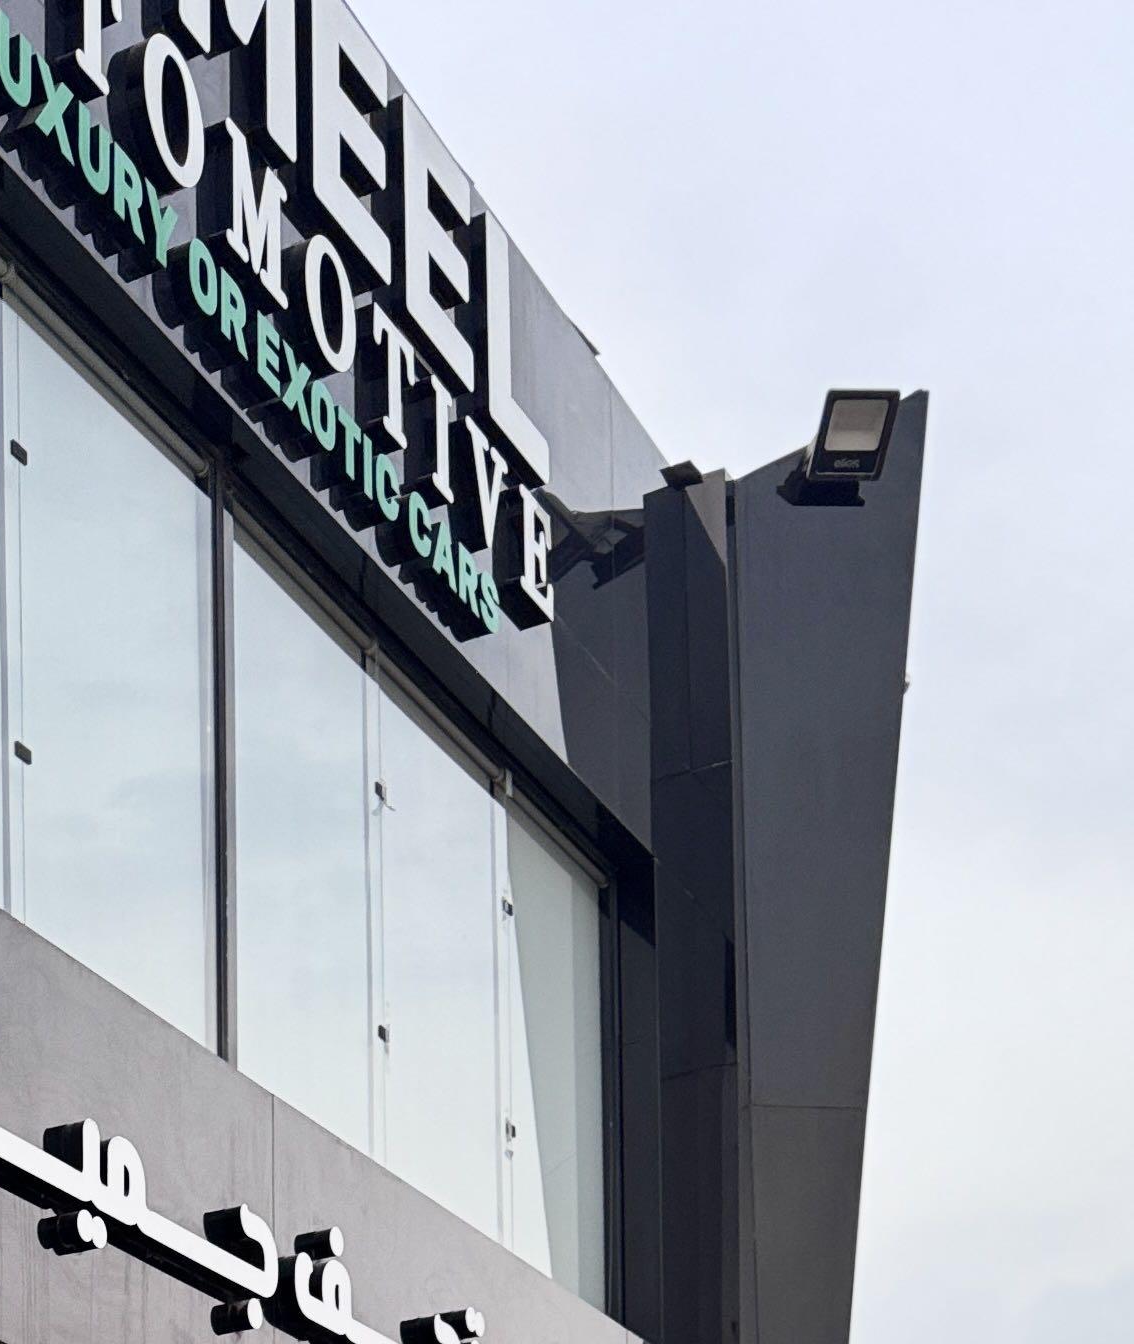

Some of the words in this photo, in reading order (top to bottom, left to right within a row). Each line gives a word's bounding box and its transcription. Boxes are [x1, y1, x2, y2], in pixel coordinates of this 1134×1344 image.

[188, 237, 247, 361] OR
[257, 314, 399, 522] EXOTIC
[408, 490, 501, 634] CARS
